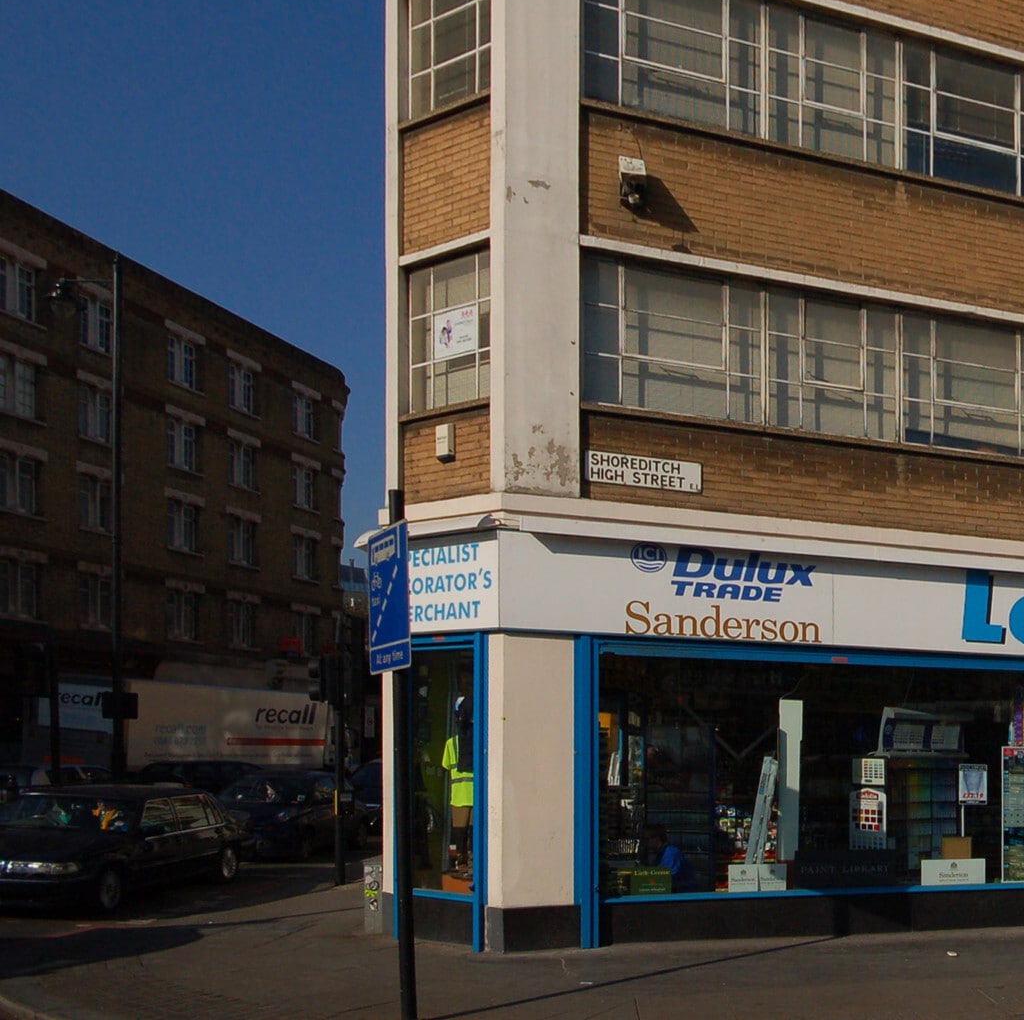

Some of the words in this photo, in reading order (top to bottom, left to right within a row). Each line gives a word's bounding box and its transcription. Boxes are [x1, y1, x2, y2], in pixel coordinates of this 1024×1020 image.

[591, 453, 681, 474] SHOREDITCH
[591, 467, 624, 482] HIGH
[633, 471, 686, 488] STREET
[638, 547, 661, 561] ICI
[673, 546, 816, 587] Dulux
[671, 580, 782, 602] TRADE
[625, 601, 822, 643] Sanderson
[256, 702, 317, 725] recall
[800, 865, 836, 875] PAINT
[842, 863, 889, 874] LIBRARY
